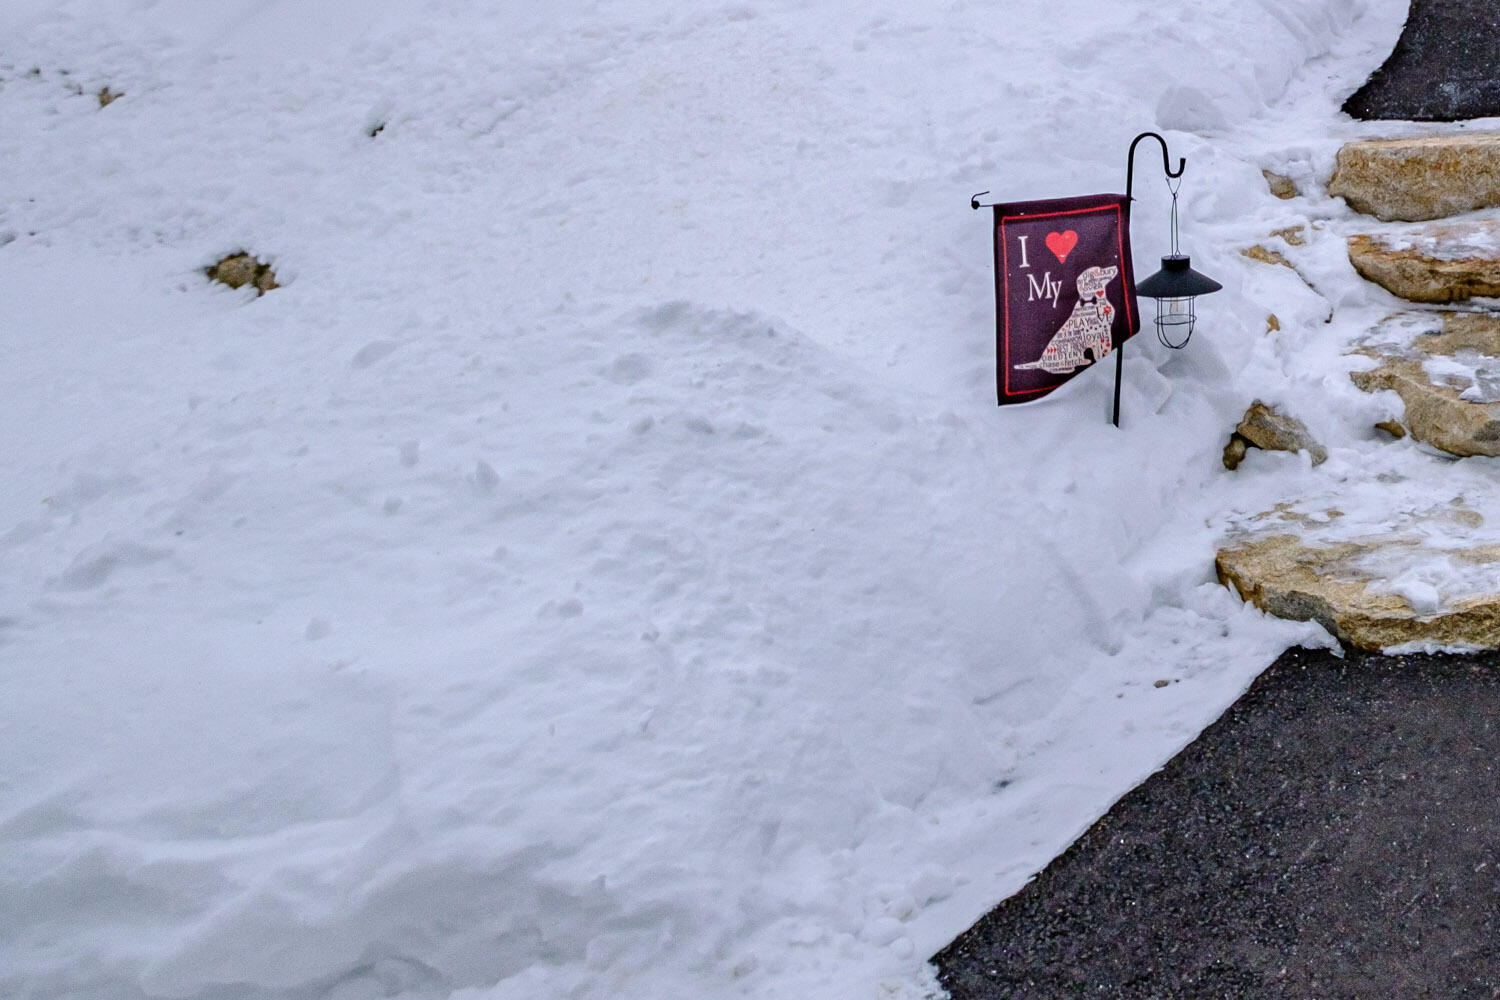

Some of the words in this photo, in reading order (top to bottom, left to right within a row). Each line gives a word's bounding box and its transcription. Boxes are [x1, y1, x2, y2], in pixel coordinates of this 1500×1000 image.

[1018, 235, 1031, 268] I
[1026, 271, 1063, 309] My
[1068, 318, 1090, 328] PLAY
[1041, 350, 1083, 361] OBEDIENT
[1064, 358, 1083, 367] fetch
